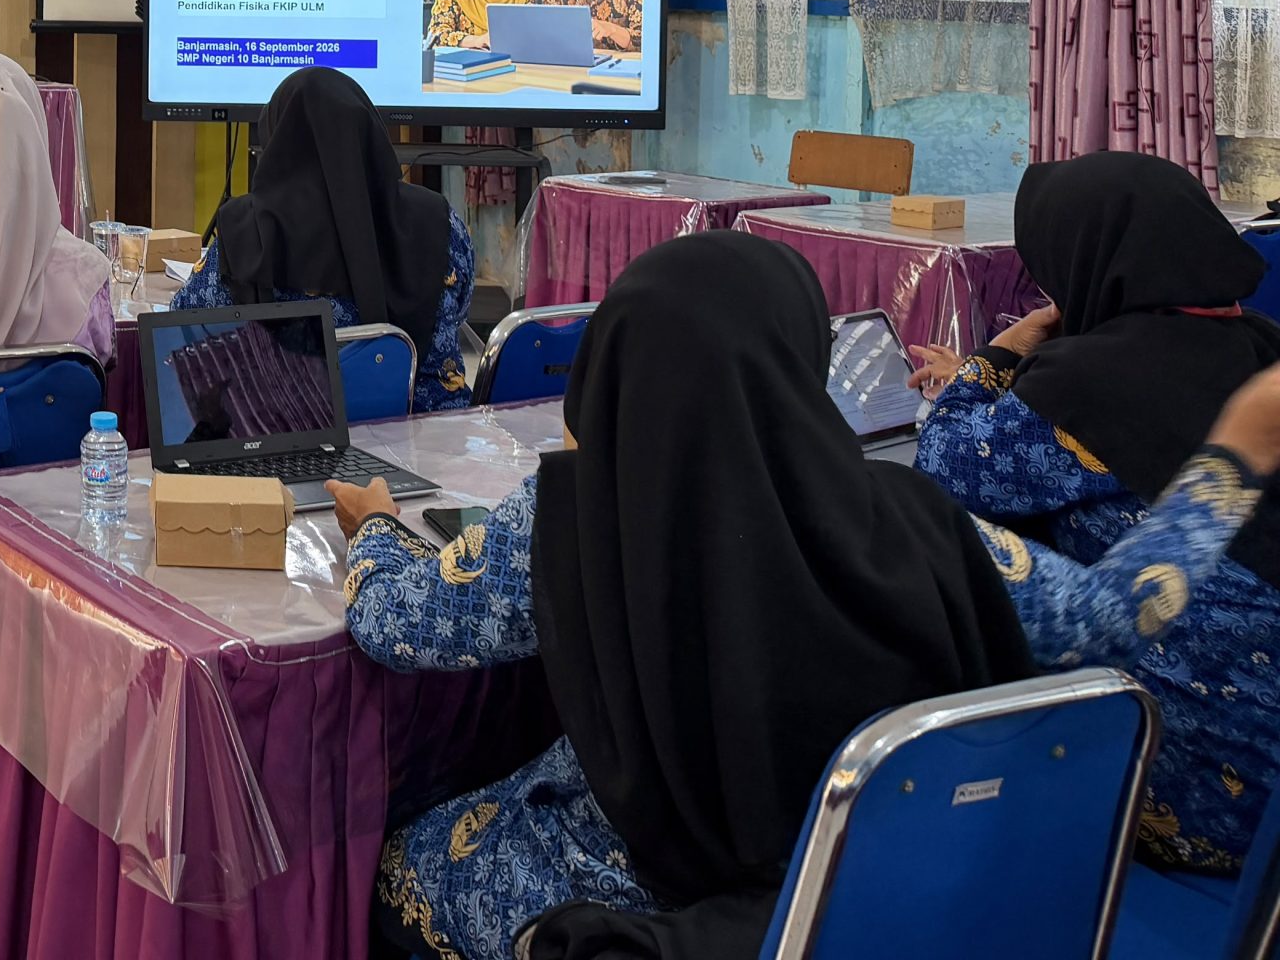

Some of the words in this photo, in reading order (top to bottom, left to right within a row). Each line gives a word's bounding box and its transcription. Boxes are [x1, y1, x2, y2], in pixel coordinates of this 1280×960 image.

[177, 0, 236, 11] Pendidikan
[239, 1, 270, 11] Fisika
[273, 2, 298, 11] FKIP
[301, 2, 325, 12] ULM
[177, 41, 242, 52] Banjarmasin,
[245, 42, 257, 51] 16
[259, 42, 314, 53] September
[316, 43, 340, 52] 2026
[177, 53, 200, 63] SMP
[202, 53, 235, 65] Negeri
[237, 54, 249, 64] 10
[251, 54, 314, 66] Banjarmasin
[243, 441, 262, 450] acer
